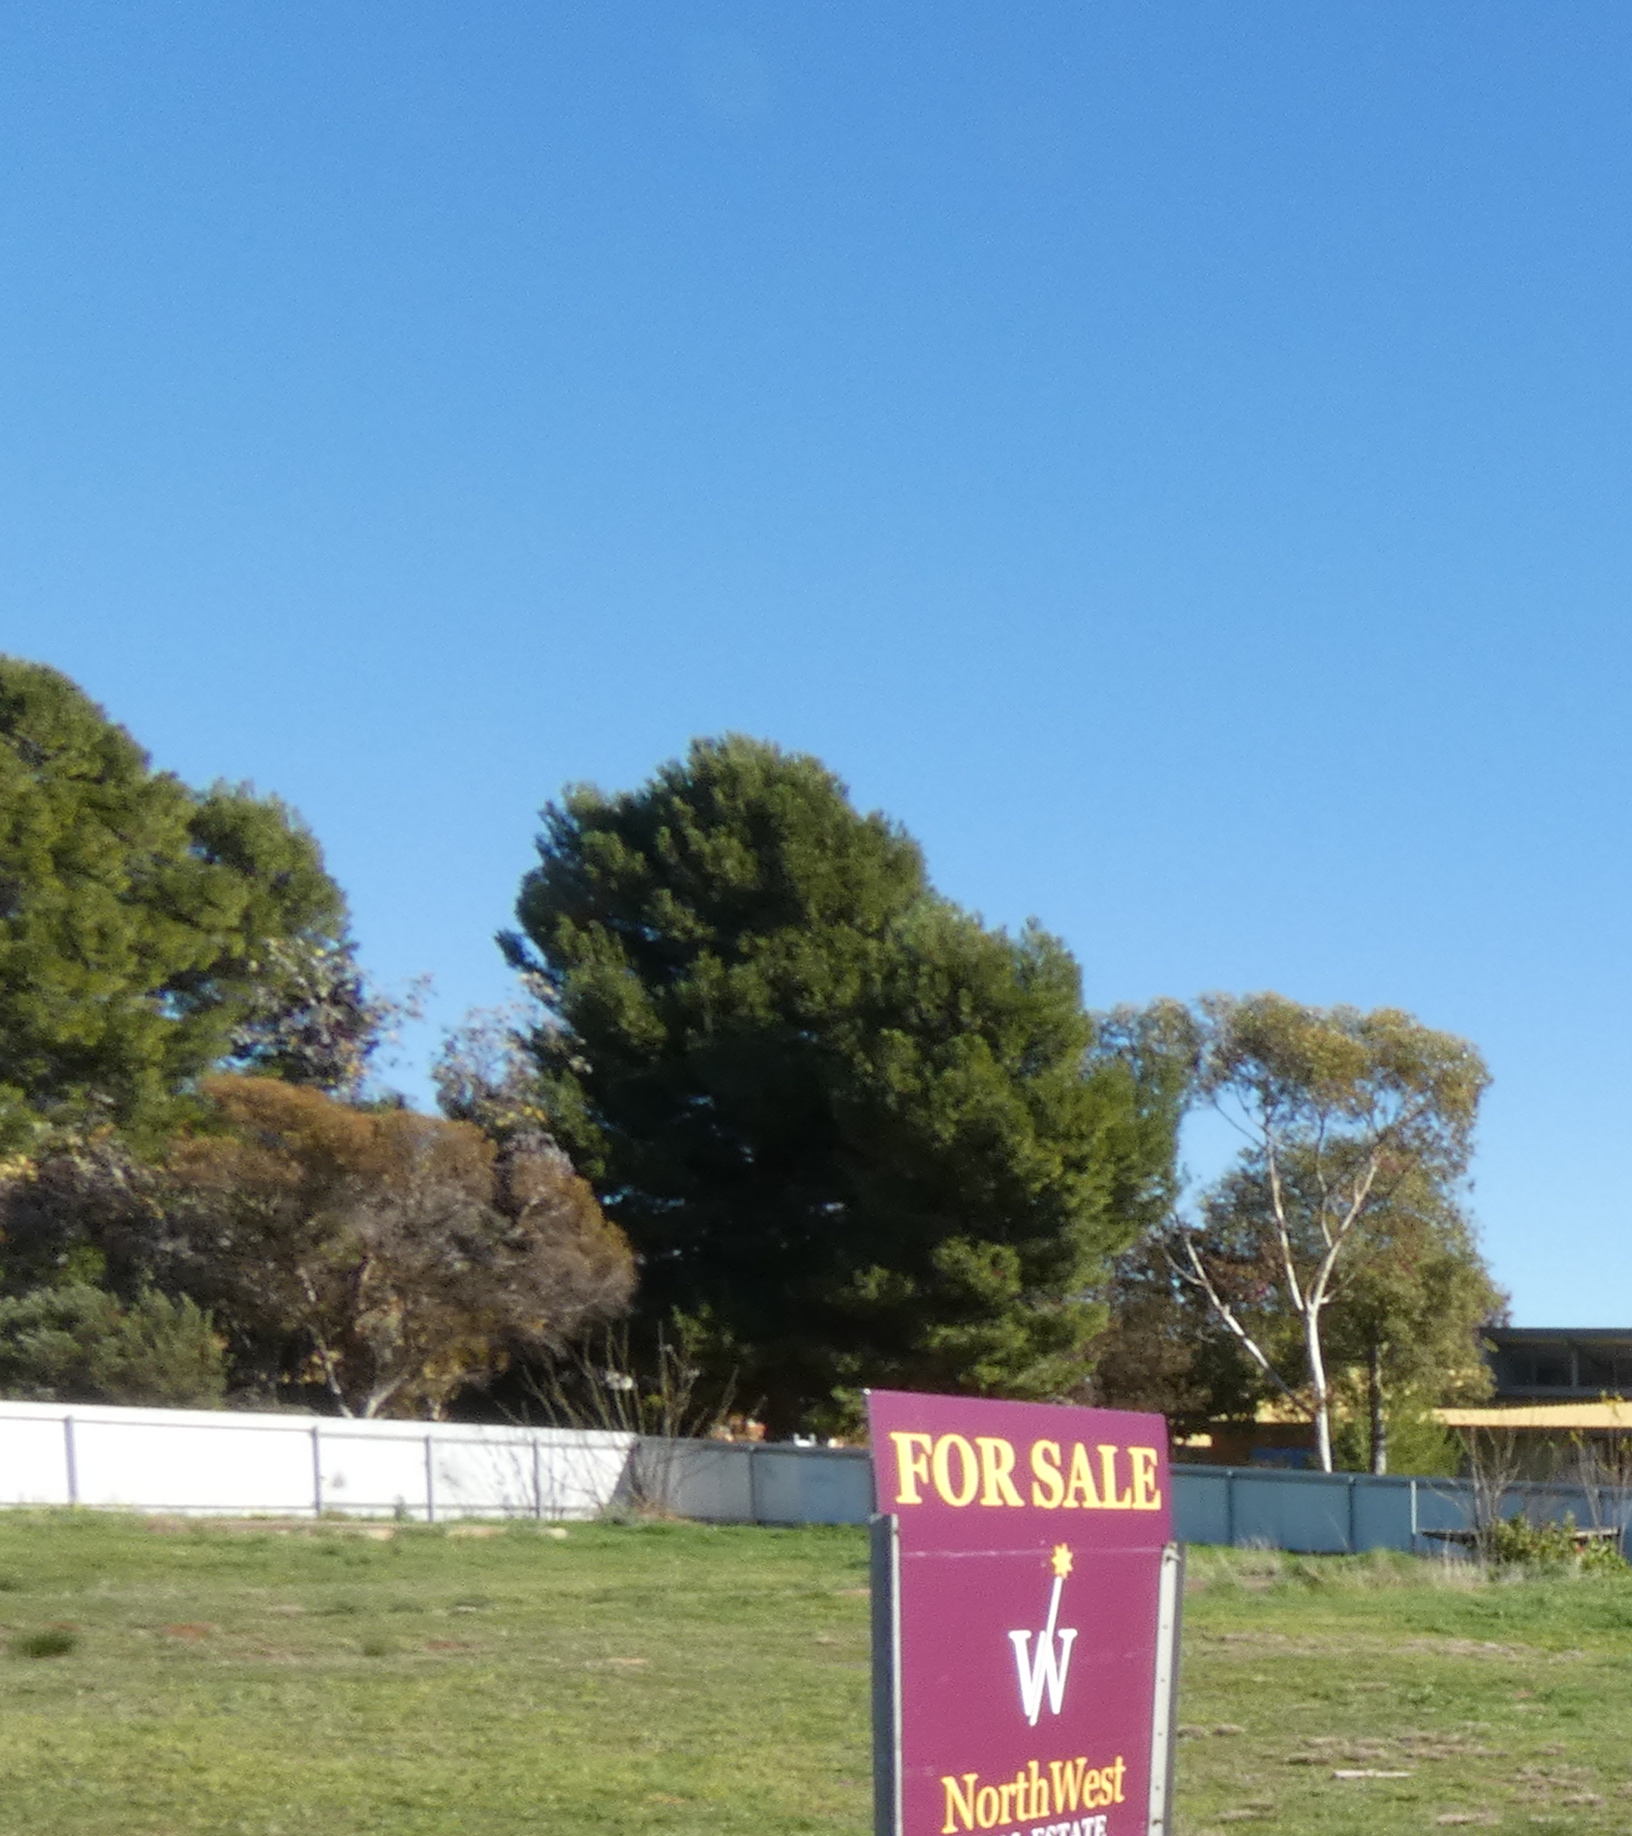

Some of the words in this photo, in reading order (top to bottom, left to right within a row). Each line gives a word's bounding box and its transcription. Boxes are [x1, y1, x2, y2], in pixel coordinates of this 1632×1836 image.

[889, 1431, 1025, 1507] FOR
[1030, 1439, 1162, 1511] SALE
[940, 1756, 1127, 1834] NorthWest
